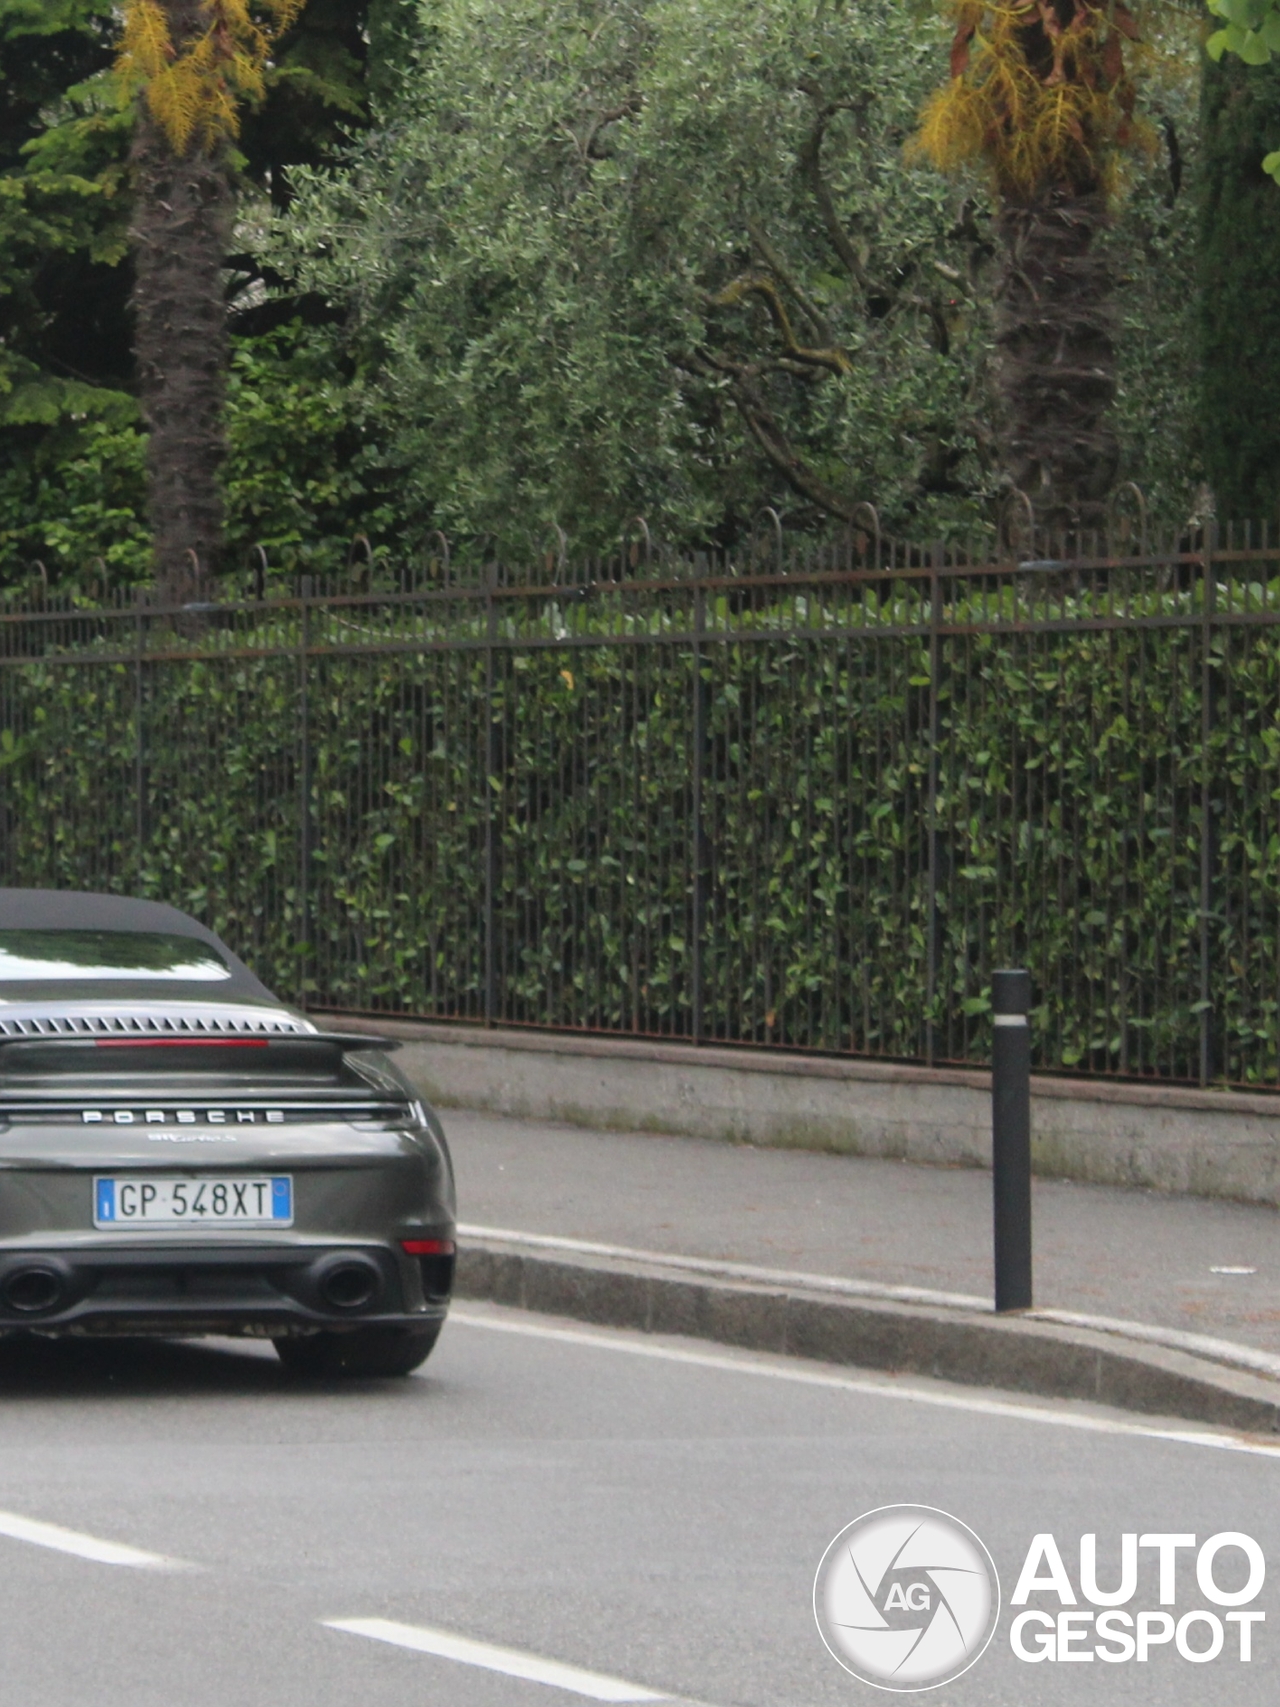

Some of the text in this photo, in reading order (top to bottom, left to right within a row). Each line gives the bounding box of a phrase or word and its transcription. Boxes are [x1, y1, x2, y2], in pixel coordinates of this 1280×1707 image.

[82, 1110, 285, 1124] PORSCHE
[120, 1183, 267, 1217] GP 548XT
